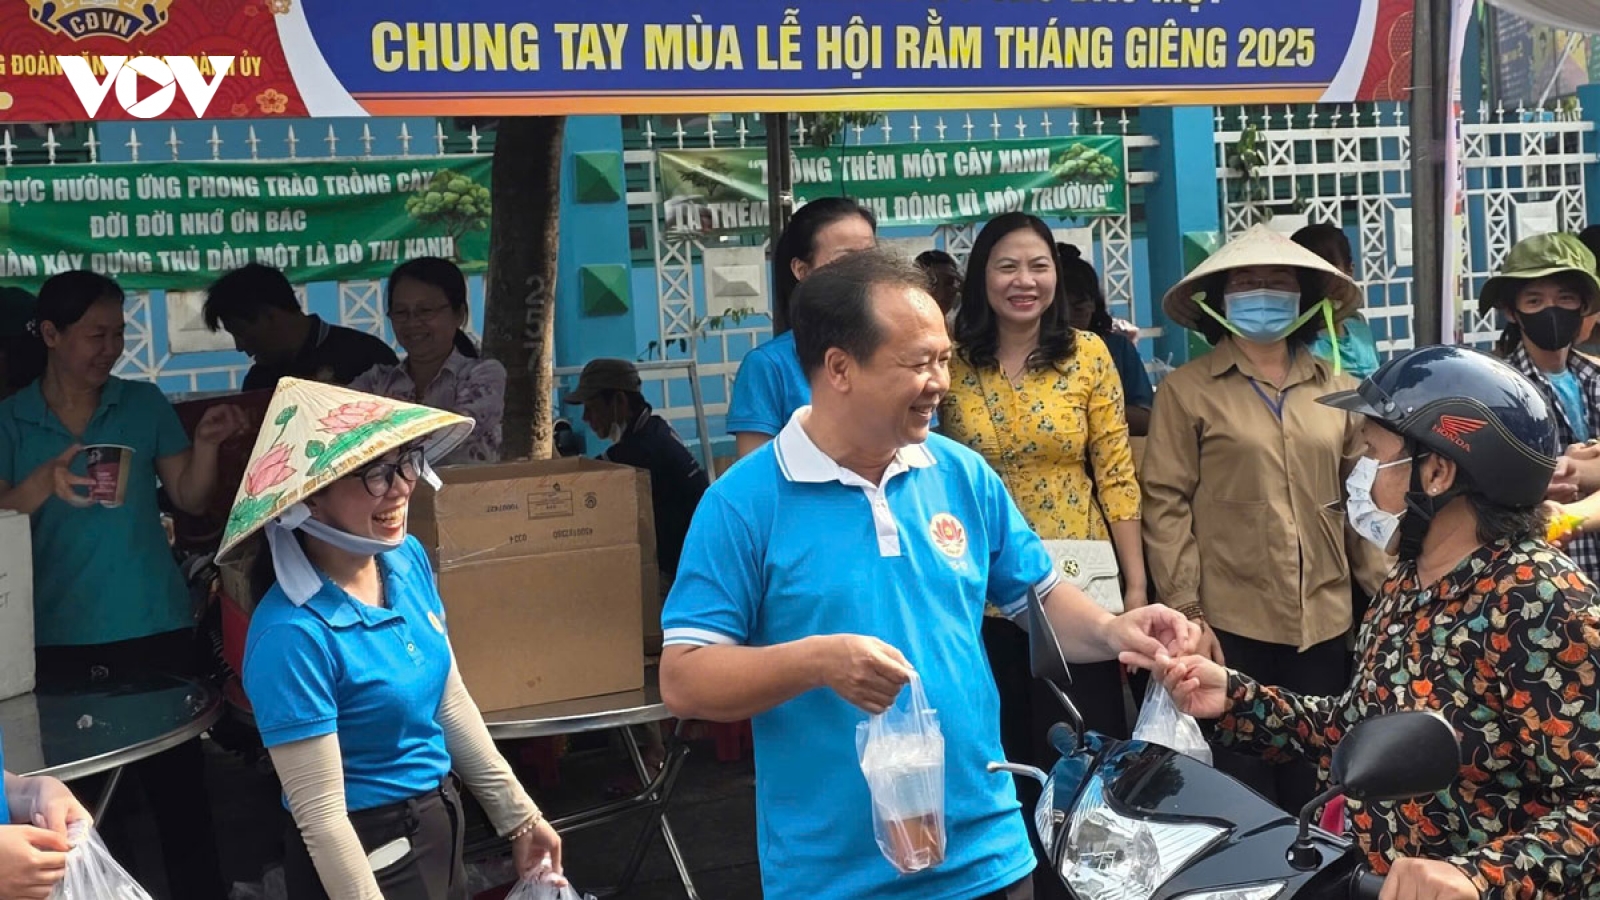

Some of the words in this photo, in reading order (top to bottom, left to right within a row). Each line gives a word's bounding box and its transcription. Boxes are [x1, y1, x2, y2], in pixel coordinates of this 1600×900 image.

[69, 12, 132, 35] CĐVN
[370, 21, 540, 72] CHUNG
[555, 23, 629, 71] TAY
[644, 15, 743, 71] MÙA
[757, 8, 802, 70] LỄ
[817, 15, 882, 79] HỘI
[896, 8, 982, 69] RẰM
[995, 17, 1113, 69] THÁNG
[1125, 19, 1226, 68] GIÊNG
[1237, 27, 1315, 67] 2025
[838, 151, 896, 180] THÊM
[903, 149, 947, 182] MỘT
[954, 147, 992, 176] CÂY
[998, 148, 1050, 173] XANH
[0, 176, 45, 207] CỰC
[52, 172, 130, 201] HƯỞNG
[136, 173, 181, 199] ỨNG
[187, 176, 260, 198] PHONG
[264, 173, 318, 197] TRÀO
[323, 168, 391, 195] TRỒNG
[396, 168, 434, 192] CÂY
[90, 212, 129, 238] ĐỜI
[135, 210, 174, 237] ĐỜI
[180, 208, 224, 235] NHỚ
[231, 208, 259, 233] ƠN
[266, 209, 307, 232] BÁC
[707, 197, 770, 229] THÊM
[893, 191, 952, 223] ĐỘNG
[956, 188, 981, 216] VÌ
[984, 186, 1025, 213] MÔI
[41, 250, 84, 275] XÂY
[92, 249, 152, 278] DỰNG
[157, 244, 199, 272] THỦ
[207, 241, 248, 271] DẦU
[256, 242, 300, 272] MỘT
[306, 241, 330, 266] LÀ
[335, 239, 364, 264] ĐÔ
[368, 240, 399, 264] THỊ
[404, 236, 455, 260] XANH
[1432, 424, 1471, 452] HONDA
